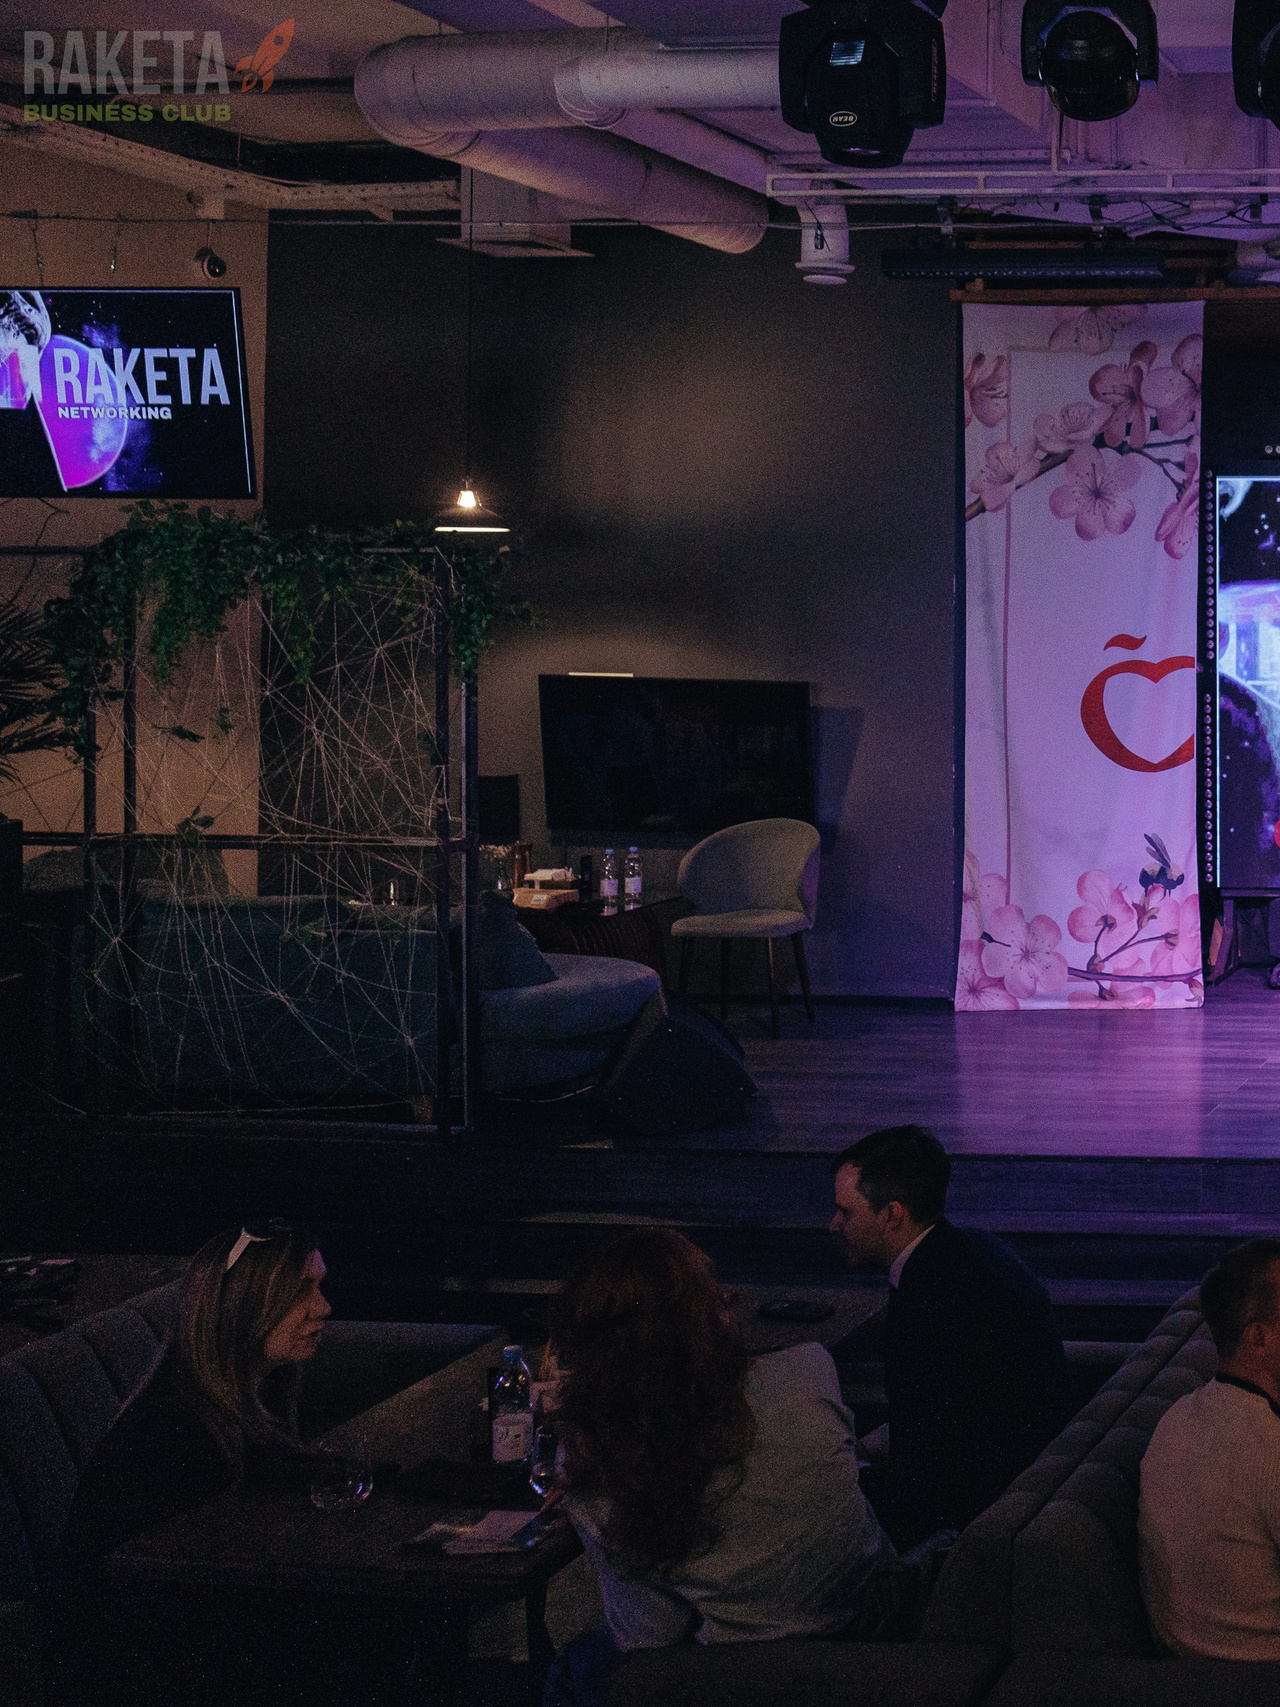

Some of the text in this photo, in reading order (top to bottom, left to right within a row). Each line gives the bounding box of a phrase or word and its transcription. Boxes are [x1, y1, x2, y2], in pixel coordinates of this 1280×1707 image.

[832, 115, 855, 123] BEAM
[53, 347, 231, 406] RAKETA
[58, 406, 172, 420] NETWORKING
